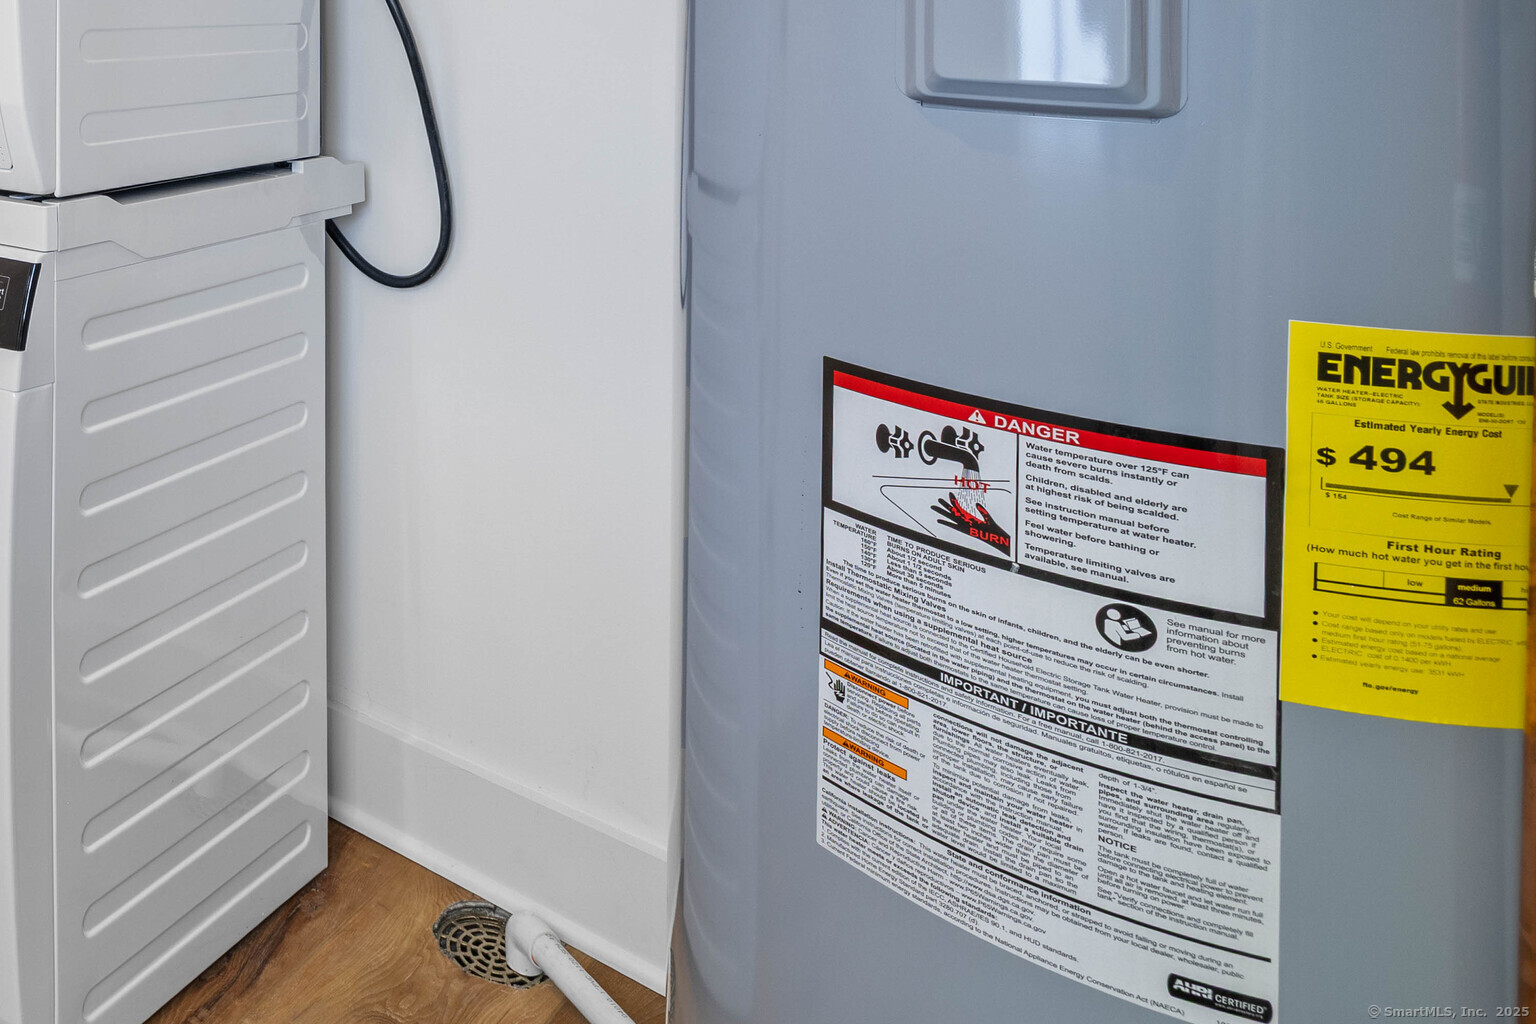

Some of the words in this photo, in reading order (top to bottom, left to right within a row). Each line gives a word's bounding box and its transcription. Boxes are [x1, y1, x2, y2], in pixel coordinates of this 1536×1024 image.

[993, 415, 1080, 445] DANGER
[1354, 419, 1406, 432] Estimated
[1409, 424, 1442, 436] Yearly
[1445, 427, 1479, 439] Energy
[1482, 429, 1503, 439] Cost
[1026, 442, 1053, 454] Water
[1055, 448, 1114, 466] temperature
[1116, 461, 1138, 470] over
[1141, 464, 1168, 476] 125°F
[1171, 471, 1190, 479] can
[1026, 452, 1054, 462] cause
[1056, 458, 1088, 470] severe
[1090, 464, 1118, 476] burns
[1121, 470, 1164, 486] instantly
[1026, 460, 1052, 472] death
[1054, 466, 1076, 476] from
[1078, 472, 1113, 484] scalds.
[1316, 446, 1337, 468] $
[1349, 445, 1436, 476] 494
[954, 474, 991, 494] HOT
[1026, 474, 1068, 490] Children,
[1070, 484, 1112, 498] disabled
[1114, 494, 1132, 503] and
[1135, 498, 1169, 510] elderly
[1172, 504, 1188, 513] are
[1025, 496, 1042, 506] See
[1045, 502, 1096, 519] instruction
[1098, 514, 1135, 527] manual
[1138, 522, 1170, 534] before
[1036, 486, 1072, 500] highest
[1074, 494, 1092, 504] risk
[1107, 500, 1134, 514] being
[1137, 508, 1180, 521] scalded.
[1025, 506, 1057, 520] setting
[1060, 514, 1118, 533] temperature
[1120, 528, 1130, 536] at
[1132, 530, 1160, 542] water
[1162, 536, 1196, 548] heater.
[1392, 512, 1409, 520] Cost
[1411, 514, 1433, 523] Range
[1442, 516, 1467, 525] Similar
[969, 527, 1010, 547] BURN
[1024, 530, 1076, 548] showering.
[1025, 519, 1044, 530] Feel
[1046, 526, 1073, 537] water
[1075, 532, 1106, 544] before
[1109, 540, 1146, 555] bathing
[1306, 544, 1336, 554] (How
[1338, 548, 1368, 559] much
[1372, 552, 1389, 561] hot
[1392, 554, 1421, 564] water
[1424, 558, 1442, 566] you
[1445, 560, 1462, 569] get
[1464, 560, 1474, 568] in
[1476, 561, 1491, 570] the
[1494, 562, 1512, 571] first
[1386, 540, 1420, 552] First
[1424, 544, 1457, 556] Hour
[1460, 547, 1502, 560] Rating
[1024, 552, 1068, 570] available,
[1071, 564, 1088, 574] see
[1090, 569, 1130, 584] manual.
[1025, 542, 1084, 564] Temperature
[1086, 558, 1122, 574] limiting
[1124, 568, 1157, 580] valves
[1159, 576, 1176, 584] are
[1406, 578, 1424, 588] low
[1456, 584, 1492, 593] medium
[894, 588, 918, 603] Mixing
[920, 598, 946, 612] Valves
[1452, 597, 1464, 606] 62
[1465, 598, 1496, 608] Gallons
[1166, 618, 1186, 628] See
[1188, 624, 1224, 636] manual
[1226, 630, 1239, 640] for
[1242, 635, 1266, 644] more
[1166, 628, 1219, 645] information
[1222, 638, 1249, 650] about
[1166, 636, 1216, 654] preventing
[1218, 646, 1246, 658] burns
[1166, 644, 1188, 655] from
[1190, 649, 1206, 659] hot
[1208, 654, 1237, 666] water.
[850, 674, 886, 698] WARNING
[940, 672, 1020, 710] IMPORTANT
[1030, 707, 1128, 745] IMPORTANTE
[848, 744, 884, 768] WARNING
[1098, 835, 1137, 853] NOTICE
